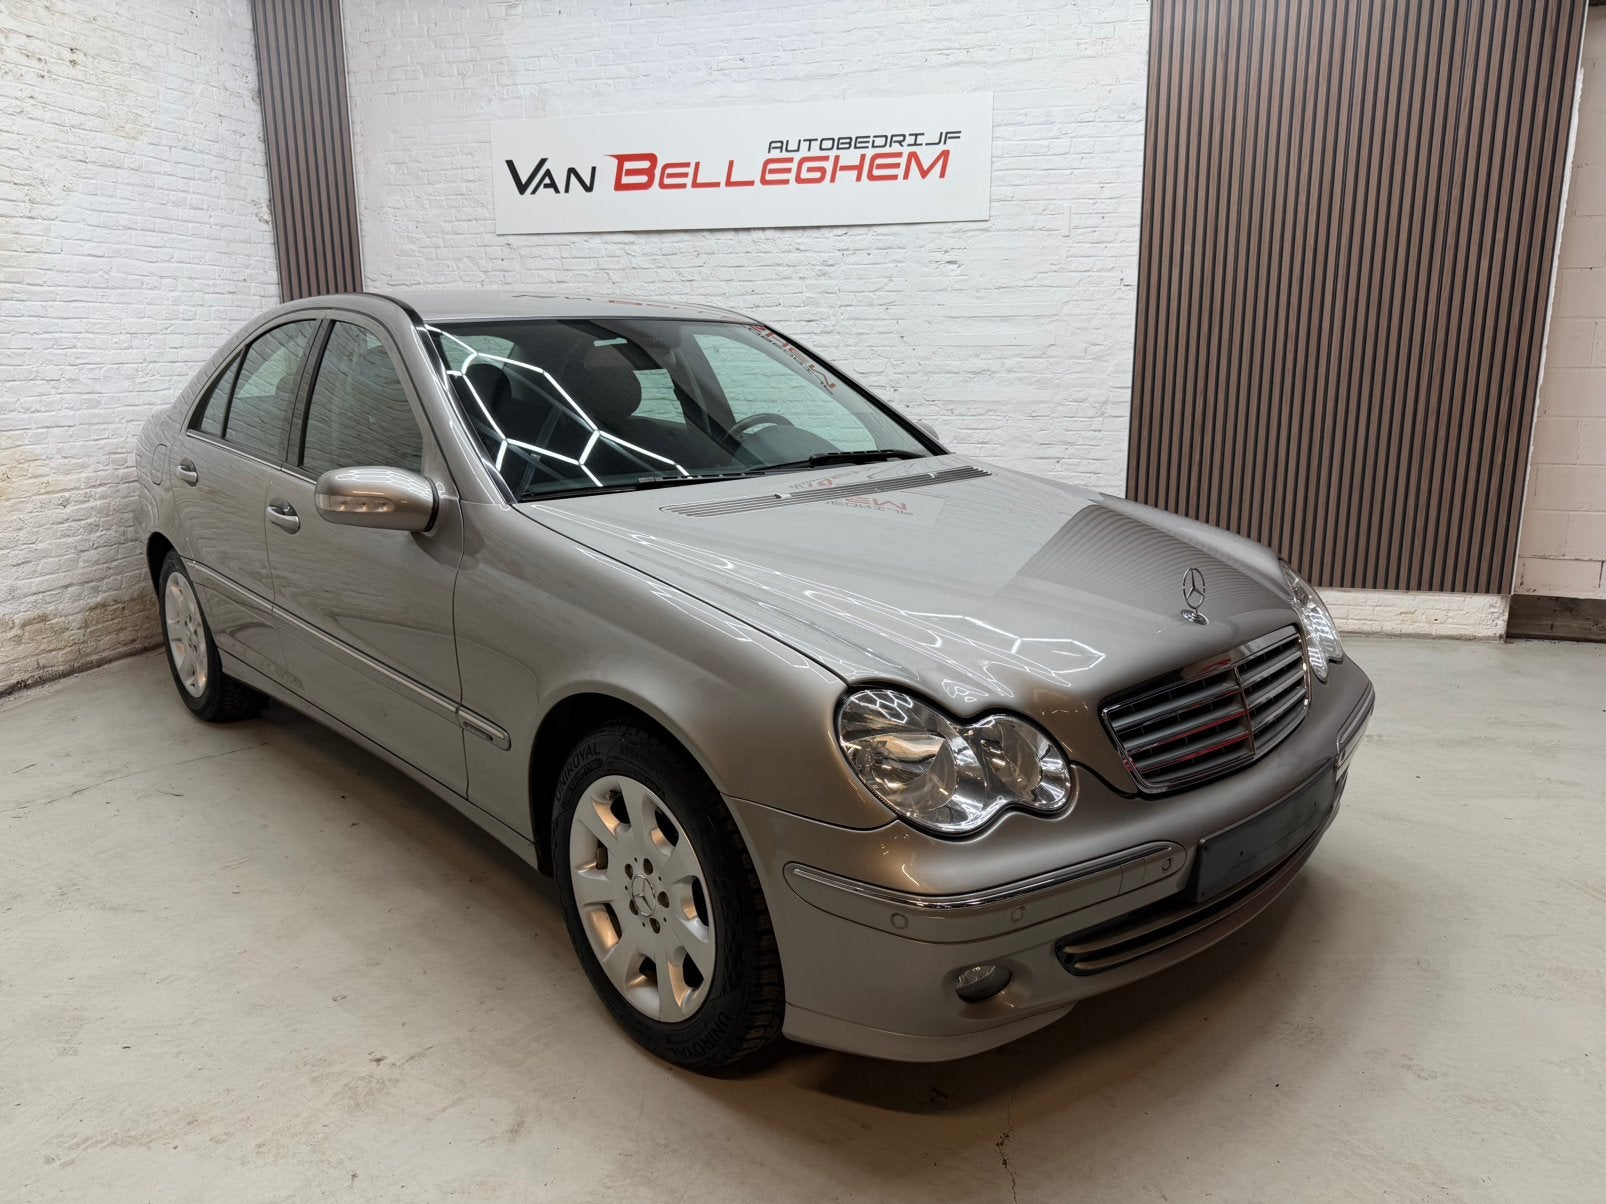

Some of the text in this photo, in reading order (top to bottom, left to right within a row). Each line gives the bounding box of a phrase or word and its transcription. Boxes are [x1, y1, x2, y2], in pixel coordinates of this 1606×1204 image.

[768, 130, 962, 154] AUTOBEDRIJF
[504, 149, 951, 196] VAN BELLEGHEM
[556, 742, 601, 802] UNIROYAL
[669, 1012, 733, 1060] UNIROYAL
